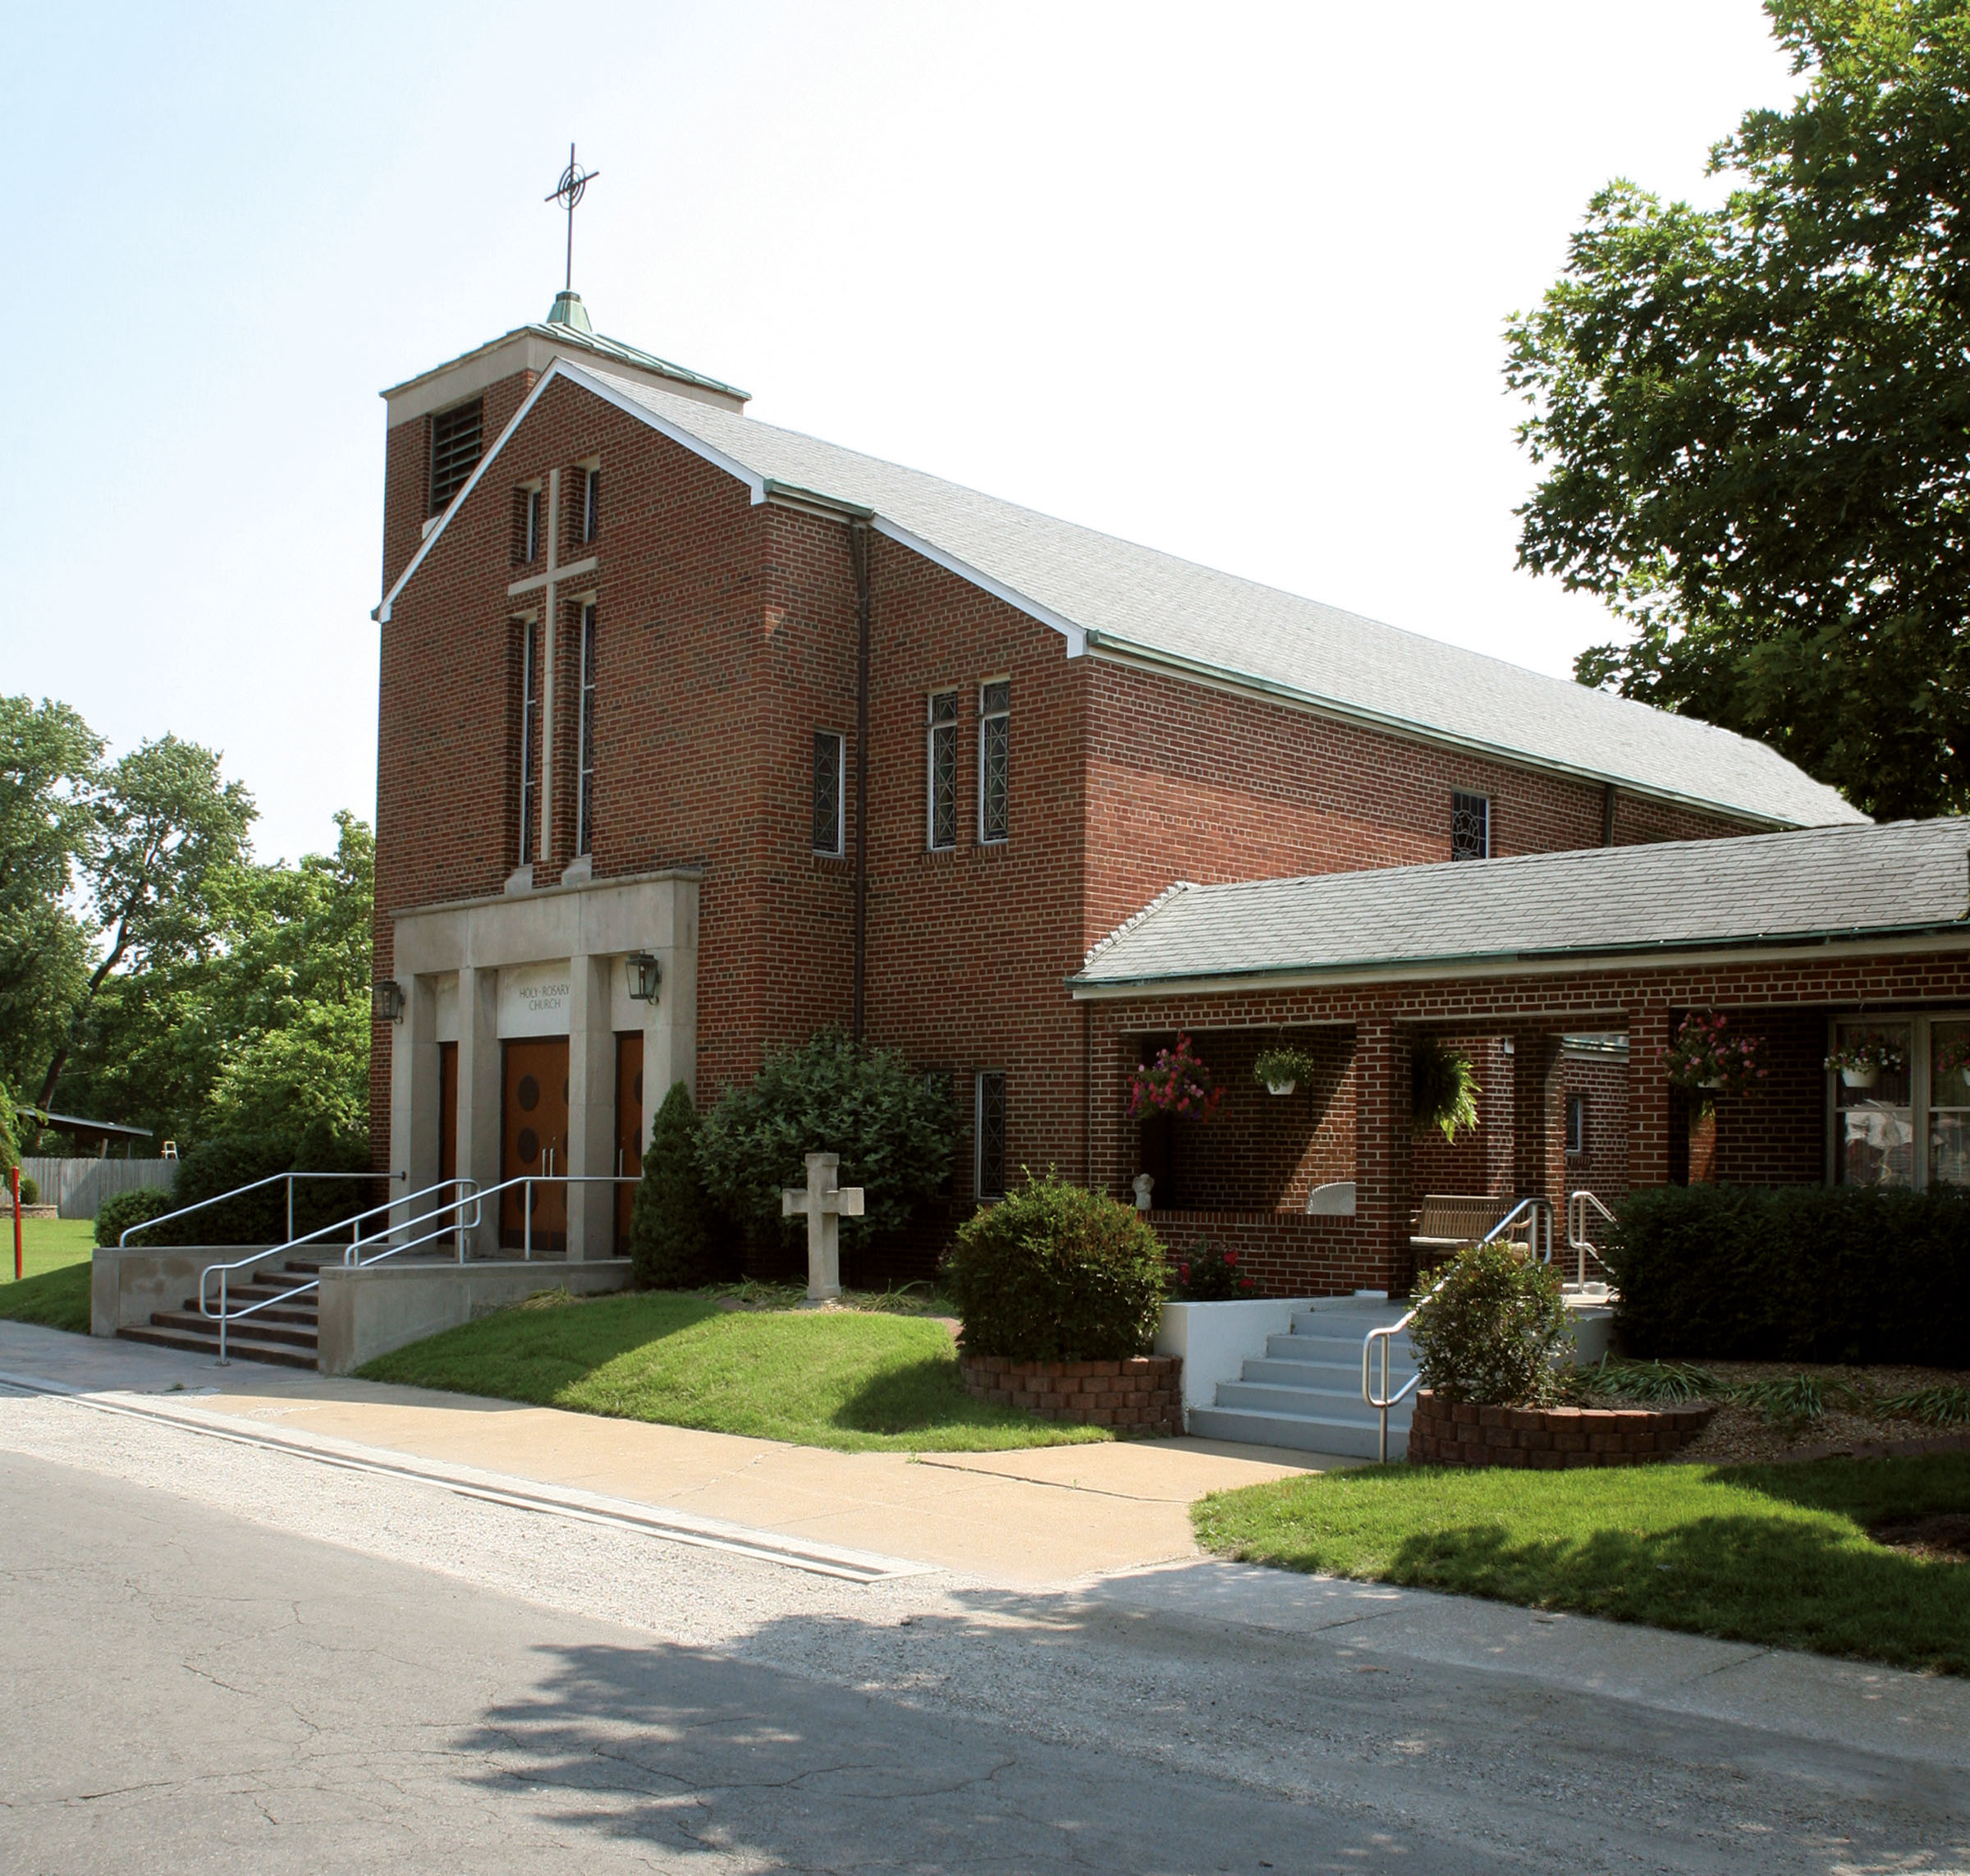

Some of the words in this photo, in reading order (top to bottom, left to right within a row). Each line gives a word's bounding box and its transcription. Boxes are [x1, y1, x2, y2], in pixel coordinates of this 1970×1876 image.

[519, 986, 538, 998] HOLY
[542, 984, 570, 996] ROSARY
[529, 998, 561, 1011] CHURCH
